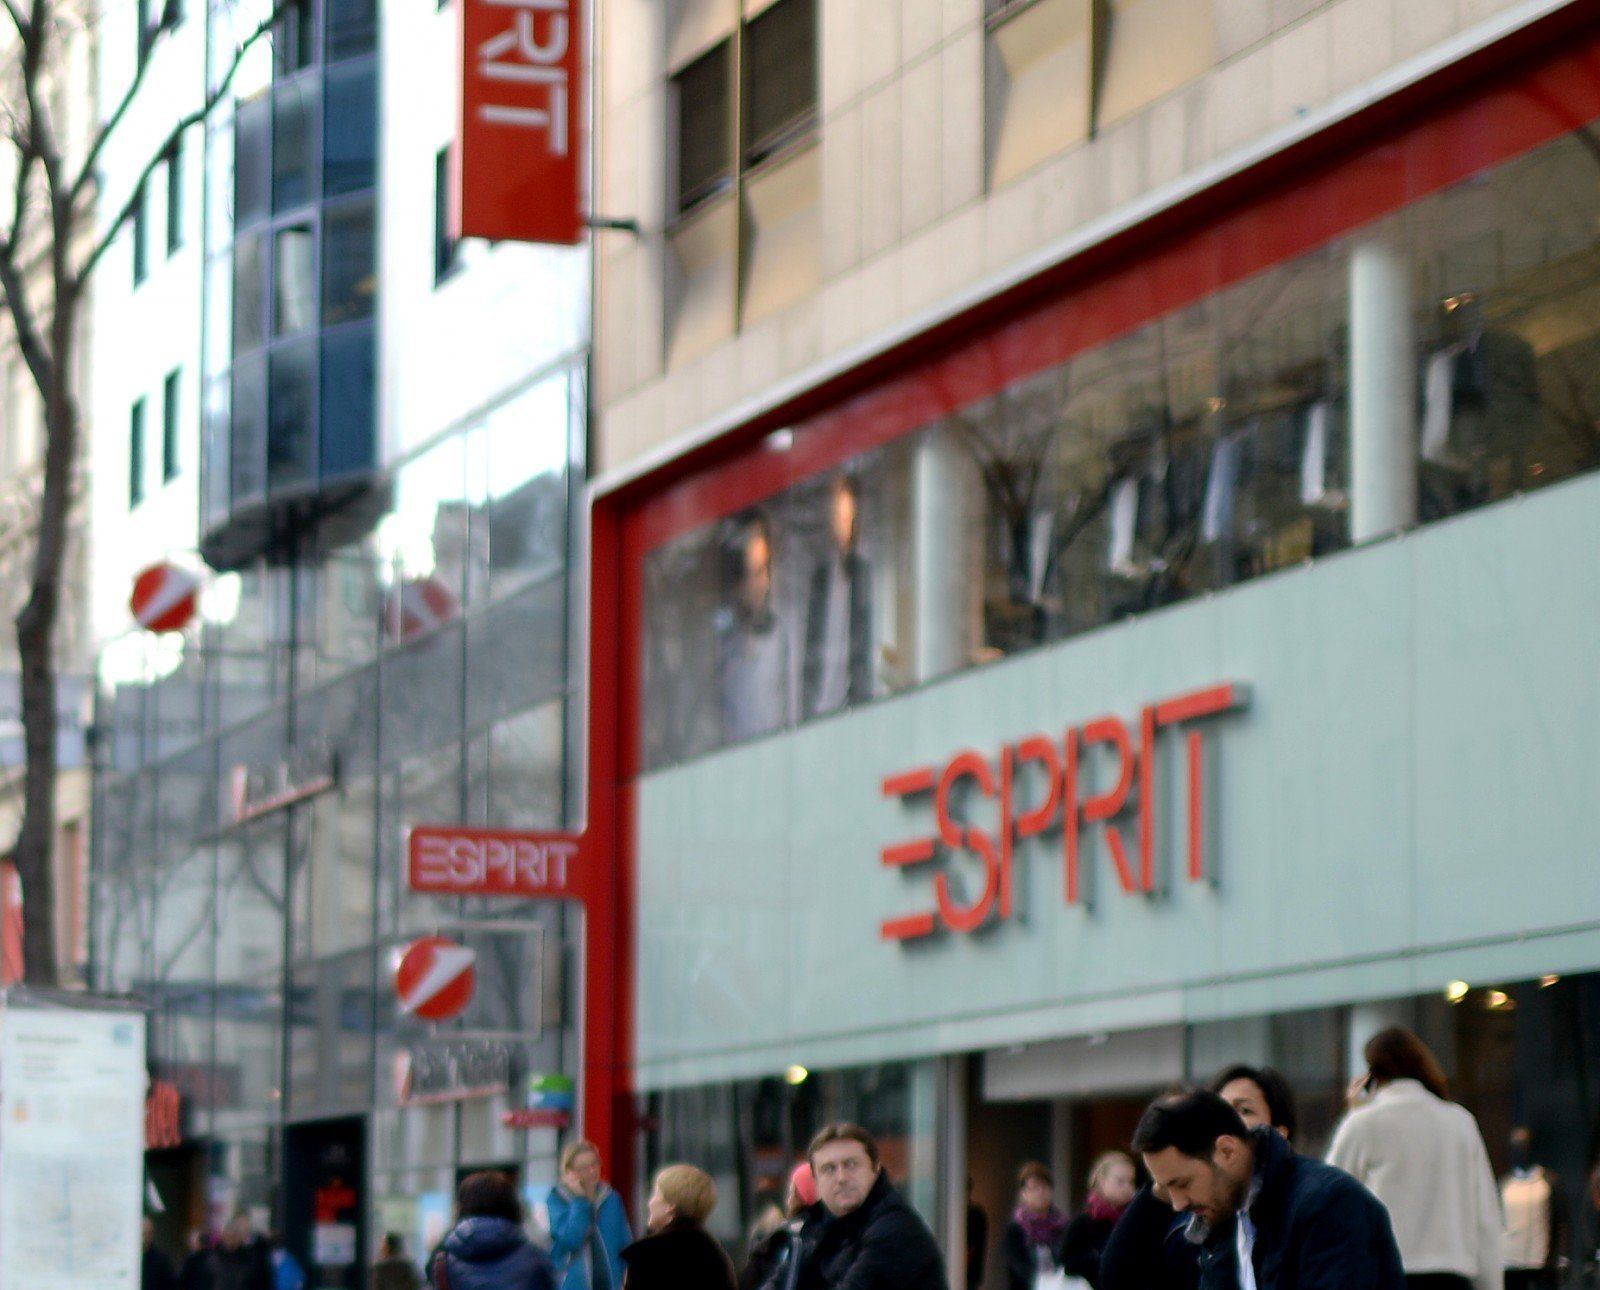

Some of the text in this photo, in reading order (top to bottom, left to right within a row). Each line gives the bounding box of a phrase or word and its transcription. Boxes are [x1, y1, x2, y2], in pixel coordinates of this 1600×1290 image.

[478, 0, 569, 157] RIT
[419, 835, 579, 889] ESPRIT
[880, 682, 1236, 941] ESPRIT
